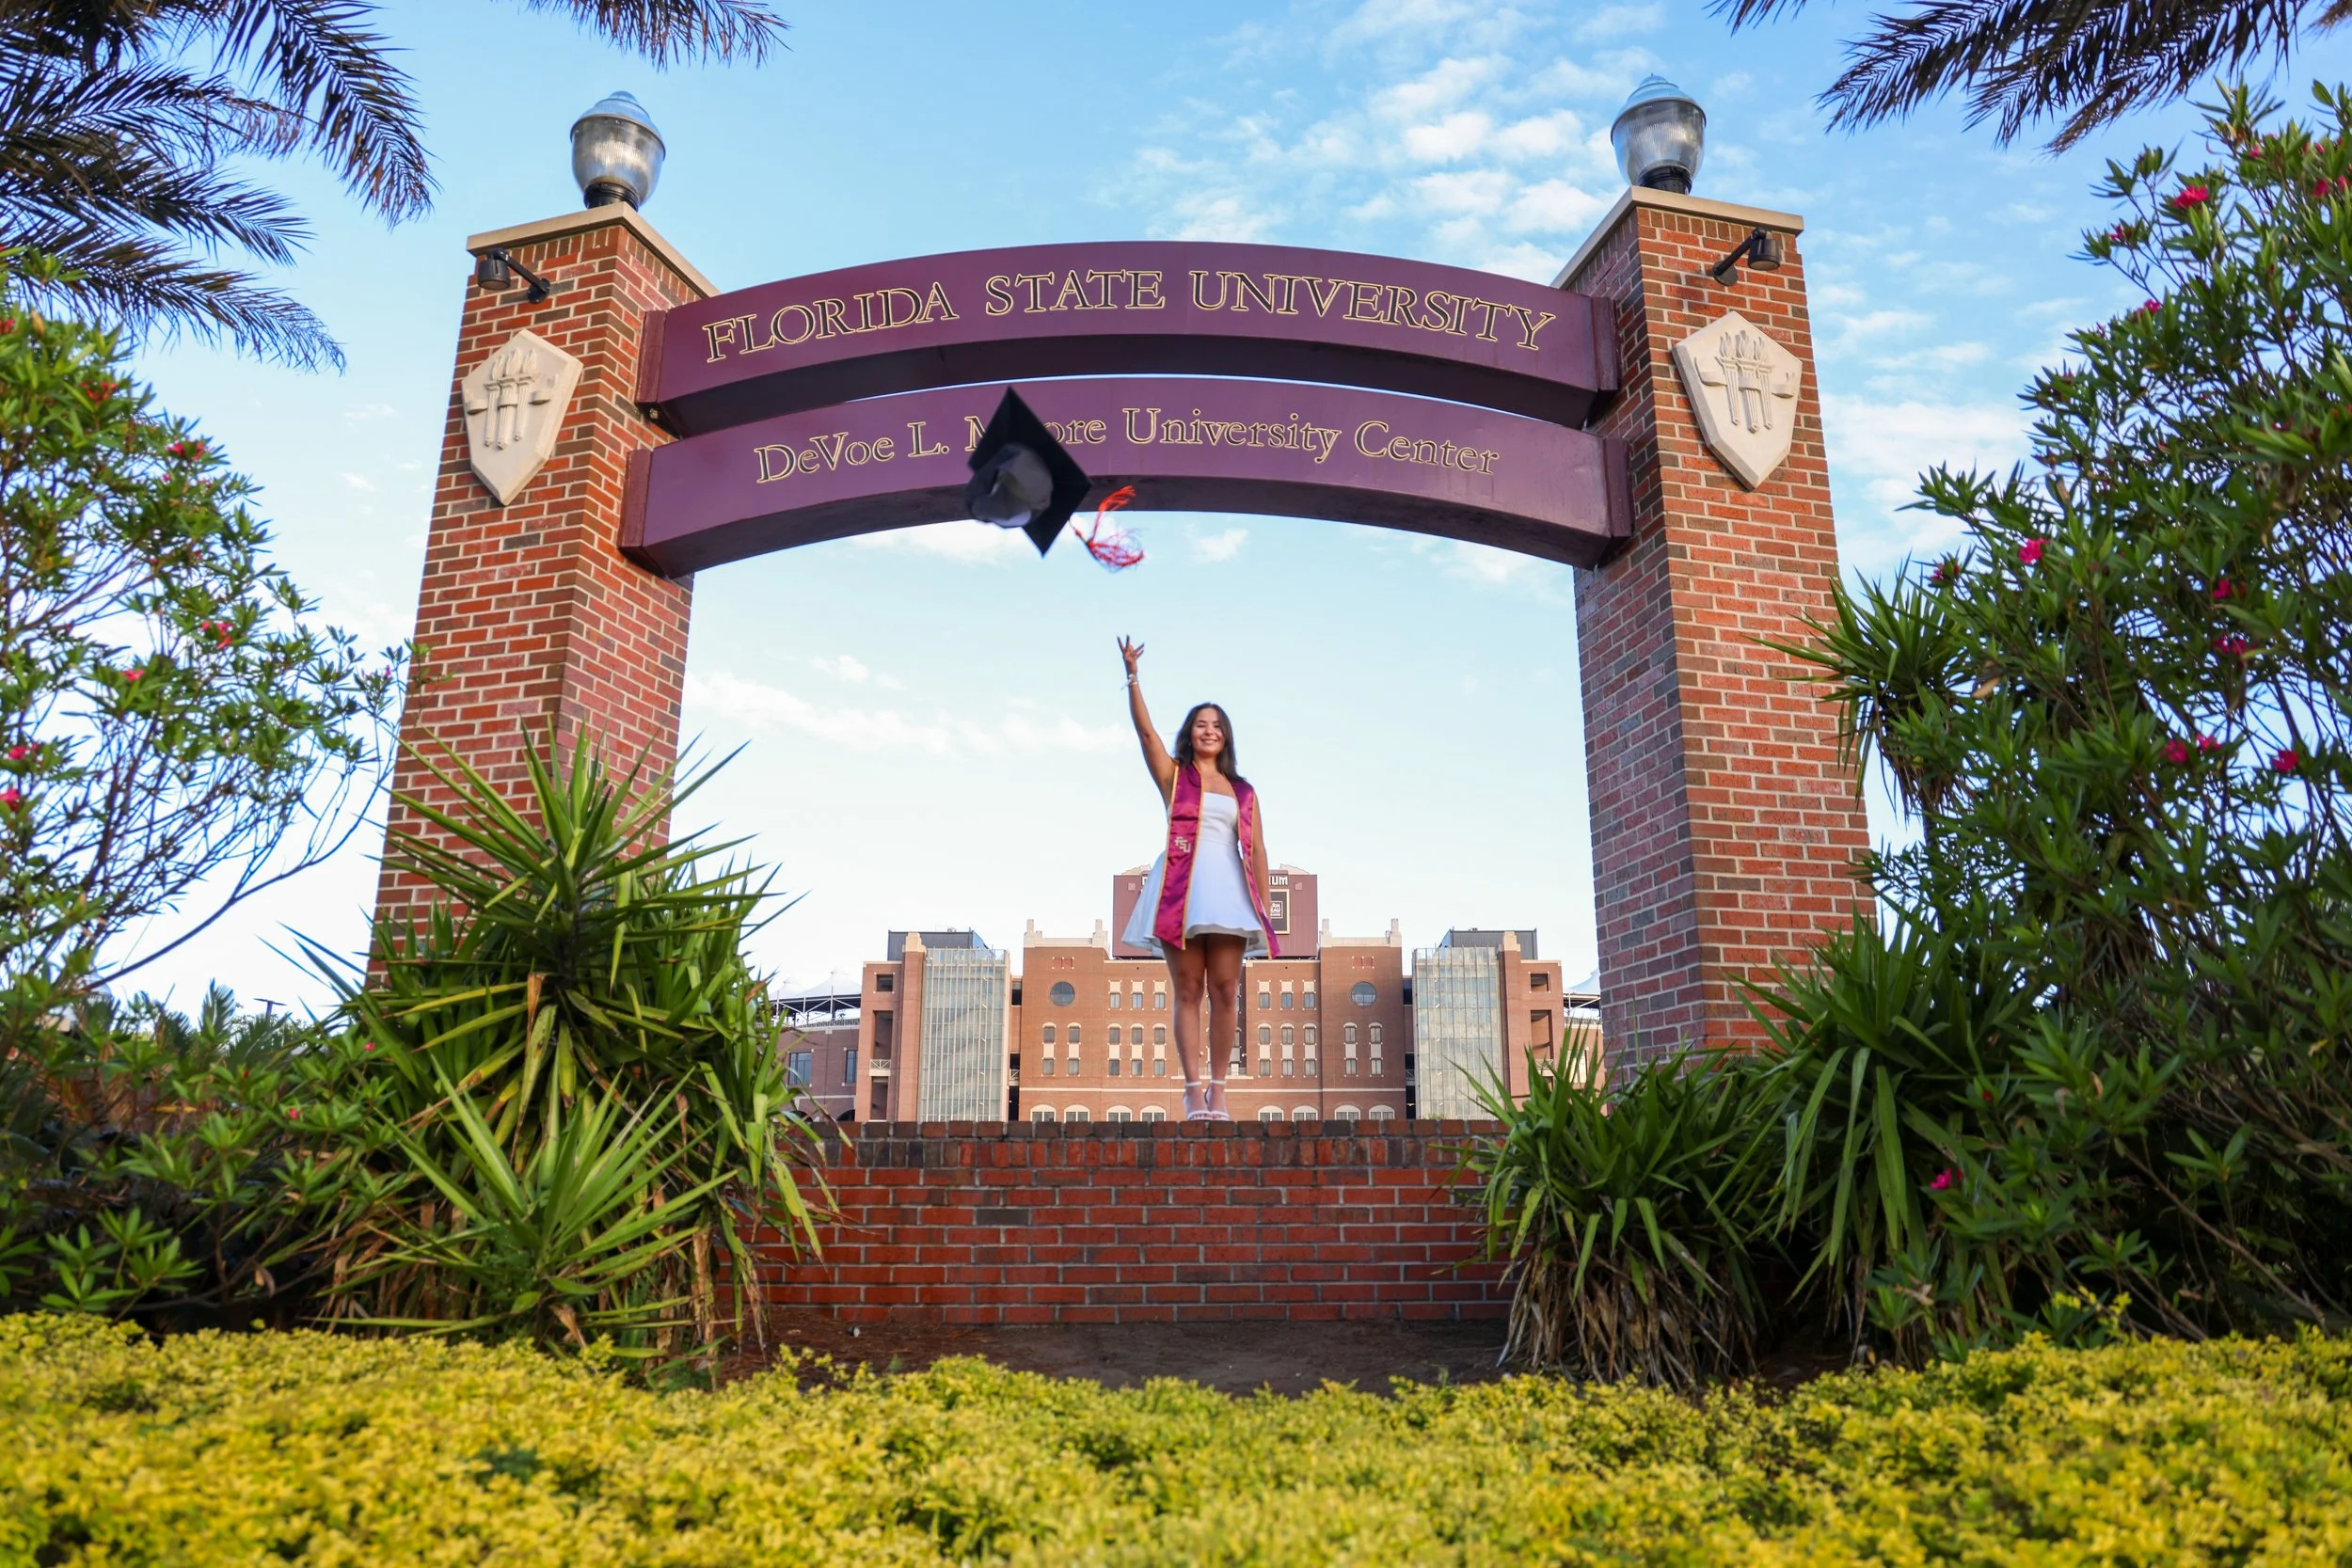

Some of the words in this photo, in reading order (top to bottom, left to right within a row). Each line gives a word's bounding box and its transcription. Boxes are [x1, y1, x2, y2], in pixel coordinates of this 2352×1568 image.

[702, 282, 960, 363] FLORIDA
[985, 269, 1166, 316] STATE
[1189, 270, 1556, 351] UNIVERSITY
[754, 432, 895, 483] DeVoe
[907, 421, 949, 458] L.
[964, 415, 1106, 451] ore
[1122, 407, 1342, 463] University
[1354, 420, 1500, 476] Center
[1174, 836, 1191, 853] FSU
